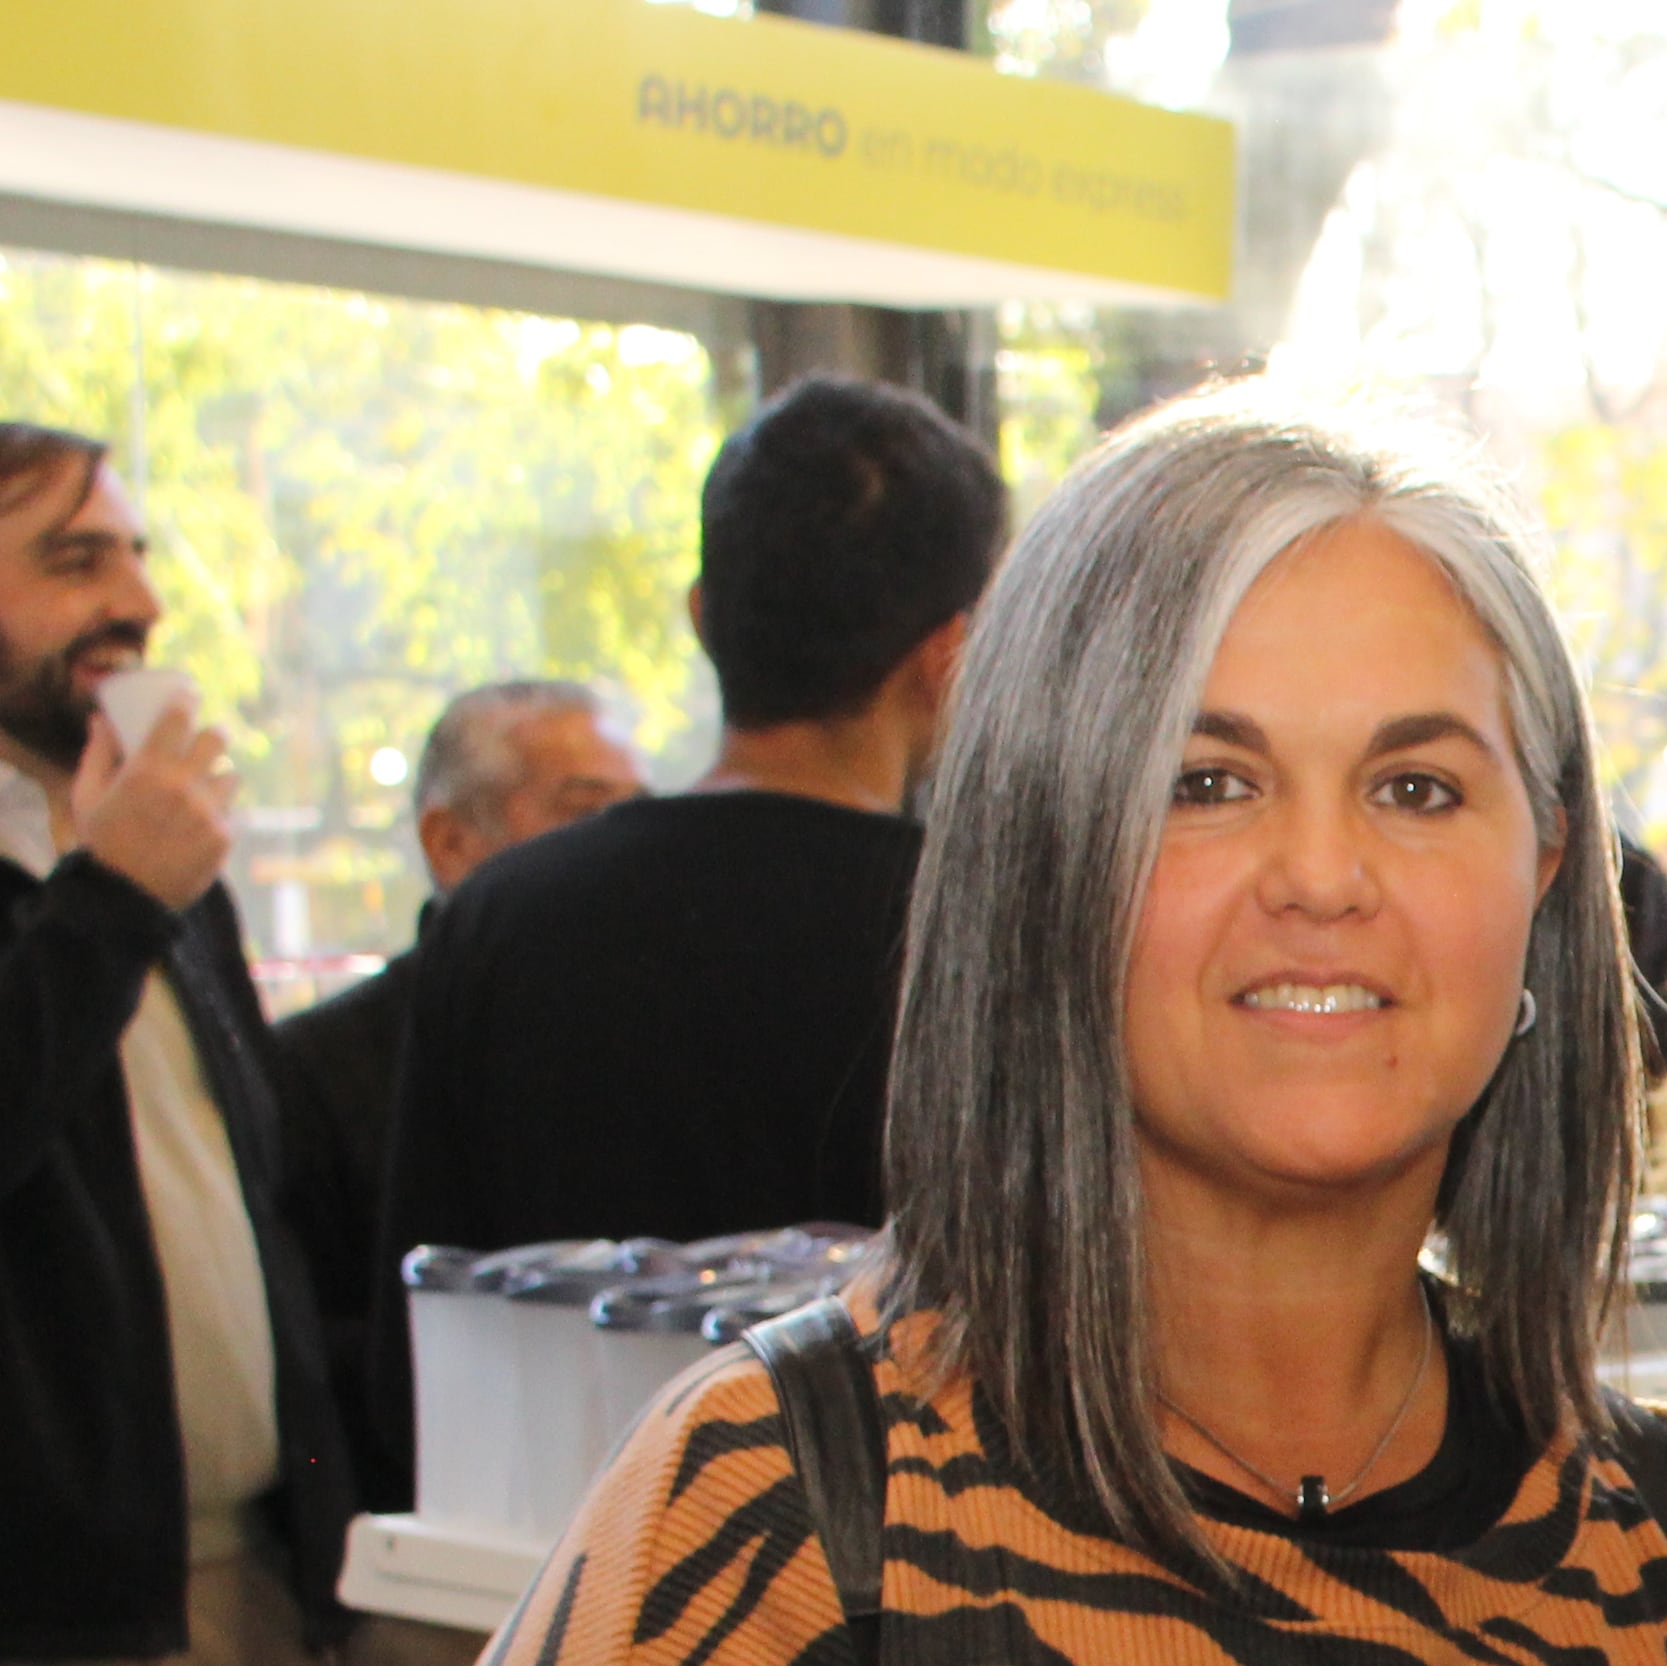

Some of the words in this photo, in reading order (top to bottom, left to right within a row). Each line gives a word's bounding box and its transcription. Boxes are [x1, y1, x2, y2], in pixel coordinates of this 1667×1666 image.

[638, 74, 849, 157] AHORRO
[860, 129, 914, 171] en
[925, 137, 1044, 197] modo
[1050, 164, 1192, 224] express
